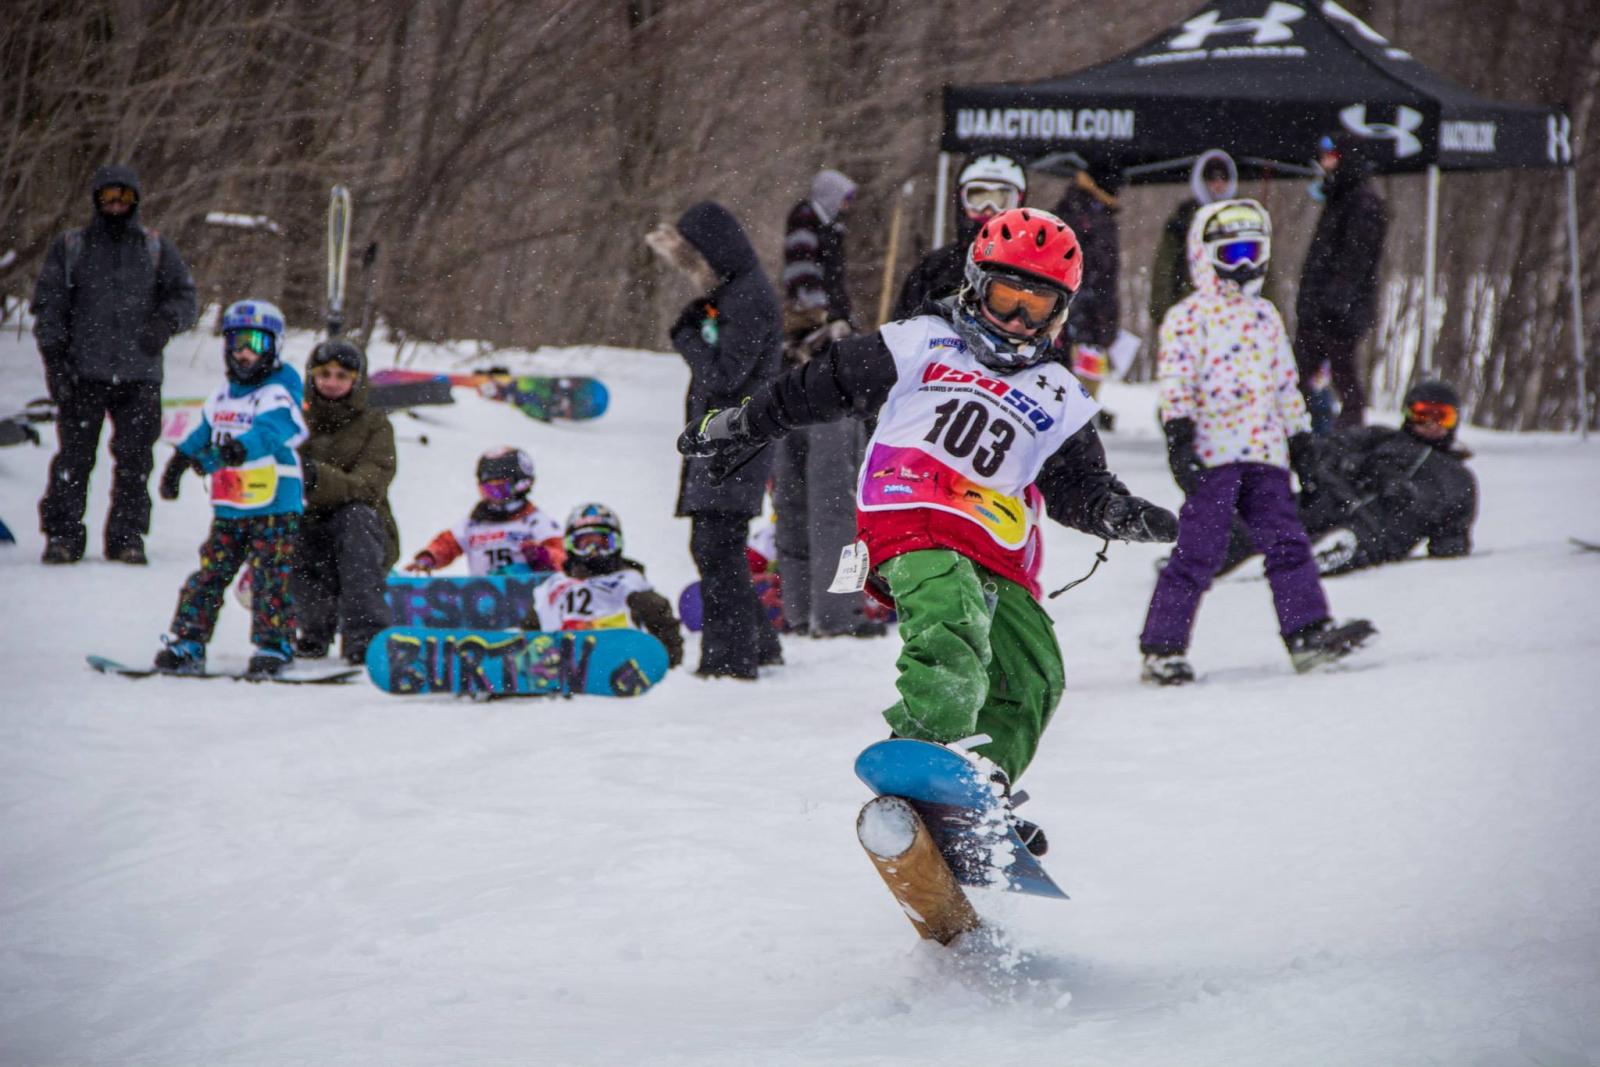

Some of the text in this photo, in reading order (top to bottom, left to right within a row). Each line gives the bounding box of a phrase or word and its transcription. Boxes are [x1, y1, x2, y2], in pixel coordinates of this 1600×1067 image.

[957, 108, 1135, 140] UAACTION.COM
[923, 398, 1016, 478] 103
[484, 547, 513, 566] 15
[566, 587, 593, 615] 12
